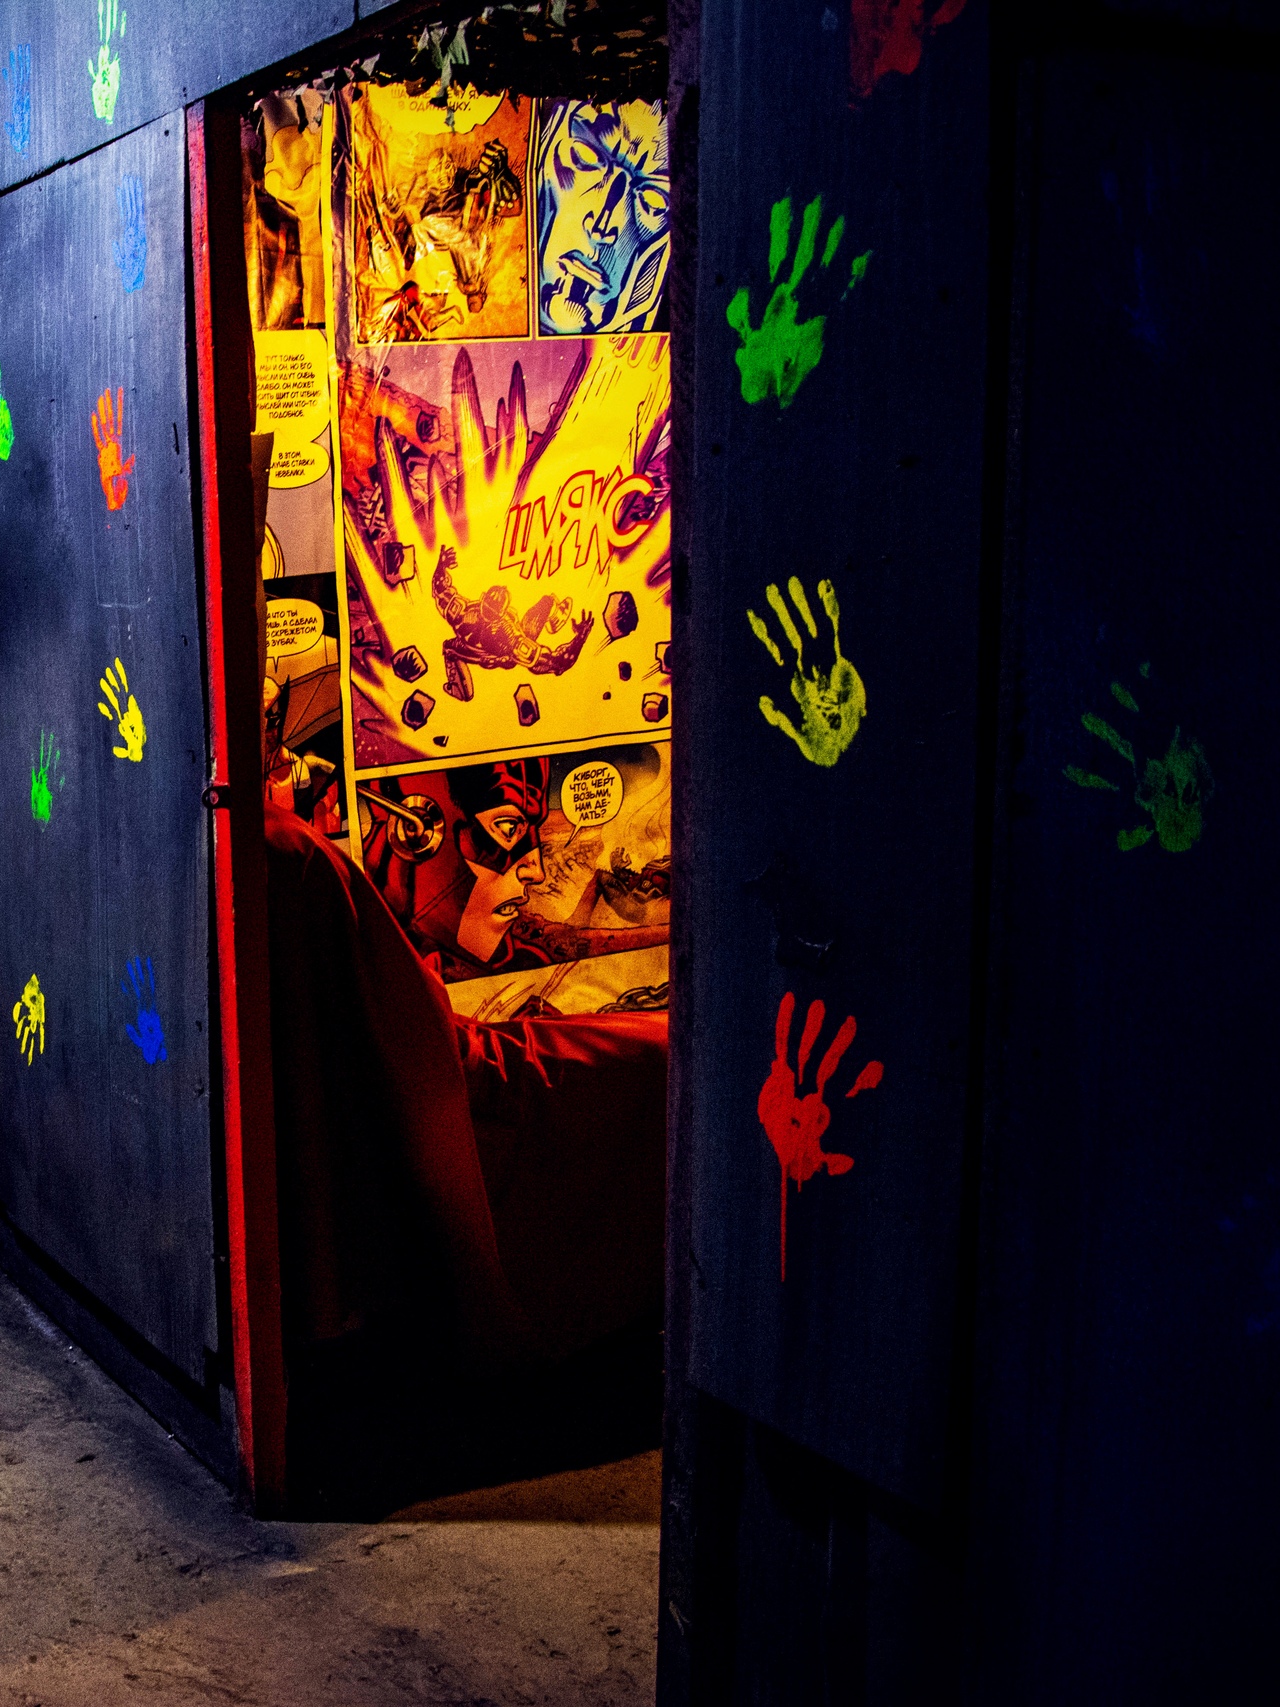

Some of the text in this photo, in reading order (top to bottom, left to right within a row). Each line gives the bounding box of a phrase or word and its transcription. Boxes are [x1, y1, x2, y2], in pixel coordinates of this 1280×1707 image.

[280, 354, 305, 362] ТОЛЬКО
[297, 372, 315, 380] ОЧЕНЬ
[292, 381, 314, 389] МОЖЕТ
[276, 392, 289, 400] ЩИТ
[285, 451, 301, 459] ЭТОМ
[291, 459, 315, 467] СТАВКИ
[286, 610, 298, 618] ТЫ
[289, 617, 317, 626] СДЕЛАЛ
[271, 626, 317, 637] СКРЕЖЕТОМ
[272, 637, 297, 647] ЗУБАХ.
[573, 767, 610, 782] КИБОРГ,
[569, 777, 615, 792] ЧТО, ЧЕРТ
[573, 788, 611, 802] ВОЗЬМИ,
[575, 798, 610, 812] НАМ ДЕ-
[580, 809, 607, 821] ЛАТЬ?
